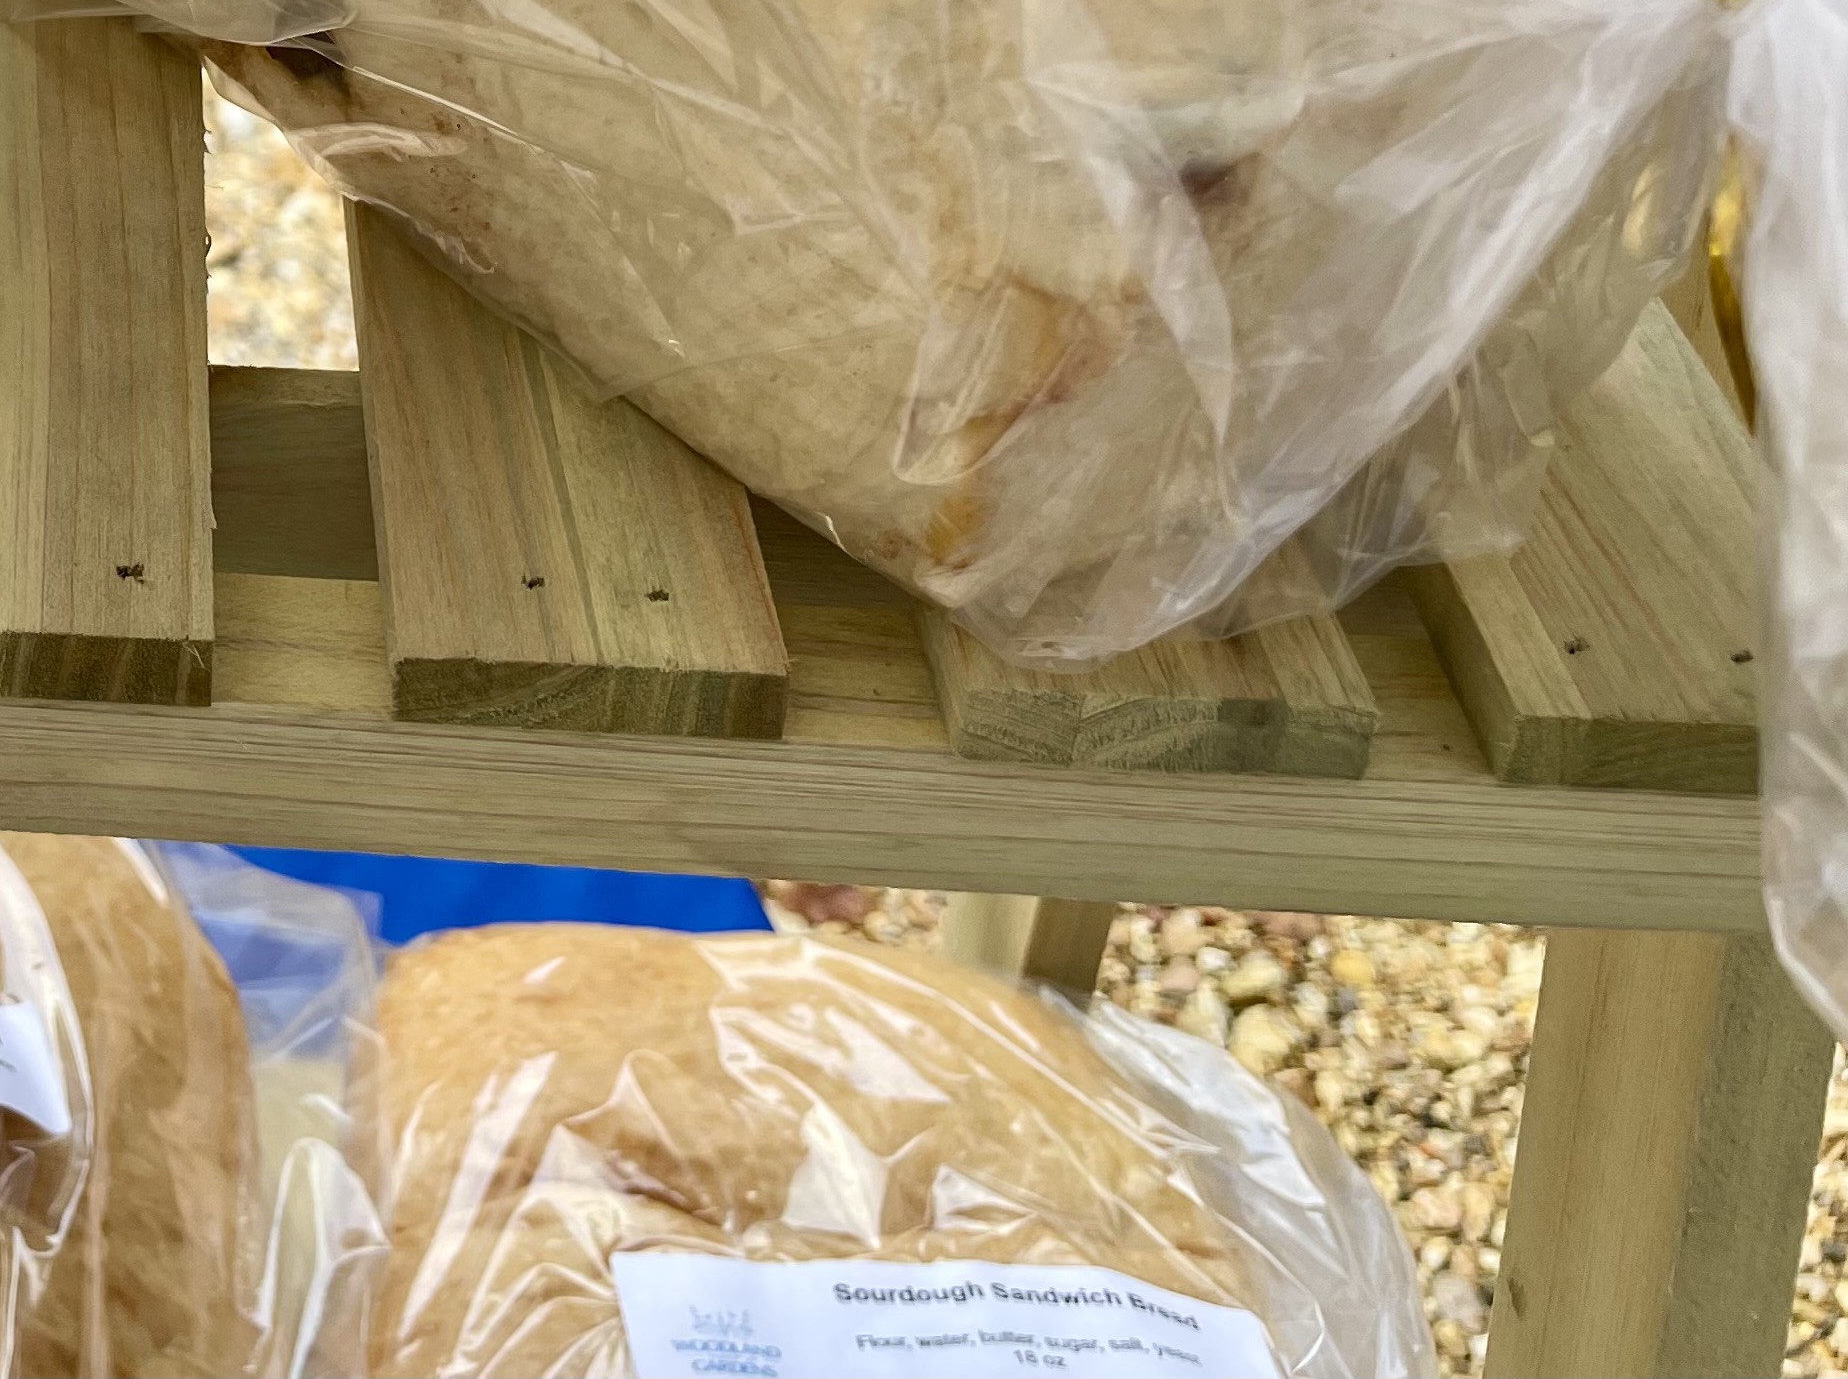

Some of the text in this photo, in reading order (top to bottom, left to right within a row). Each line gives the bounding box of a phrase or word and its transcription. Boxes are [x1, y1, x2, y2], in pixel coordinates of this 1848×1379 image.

[834, 1280, 1200, 1330] Sourdough Sandwich Bread
